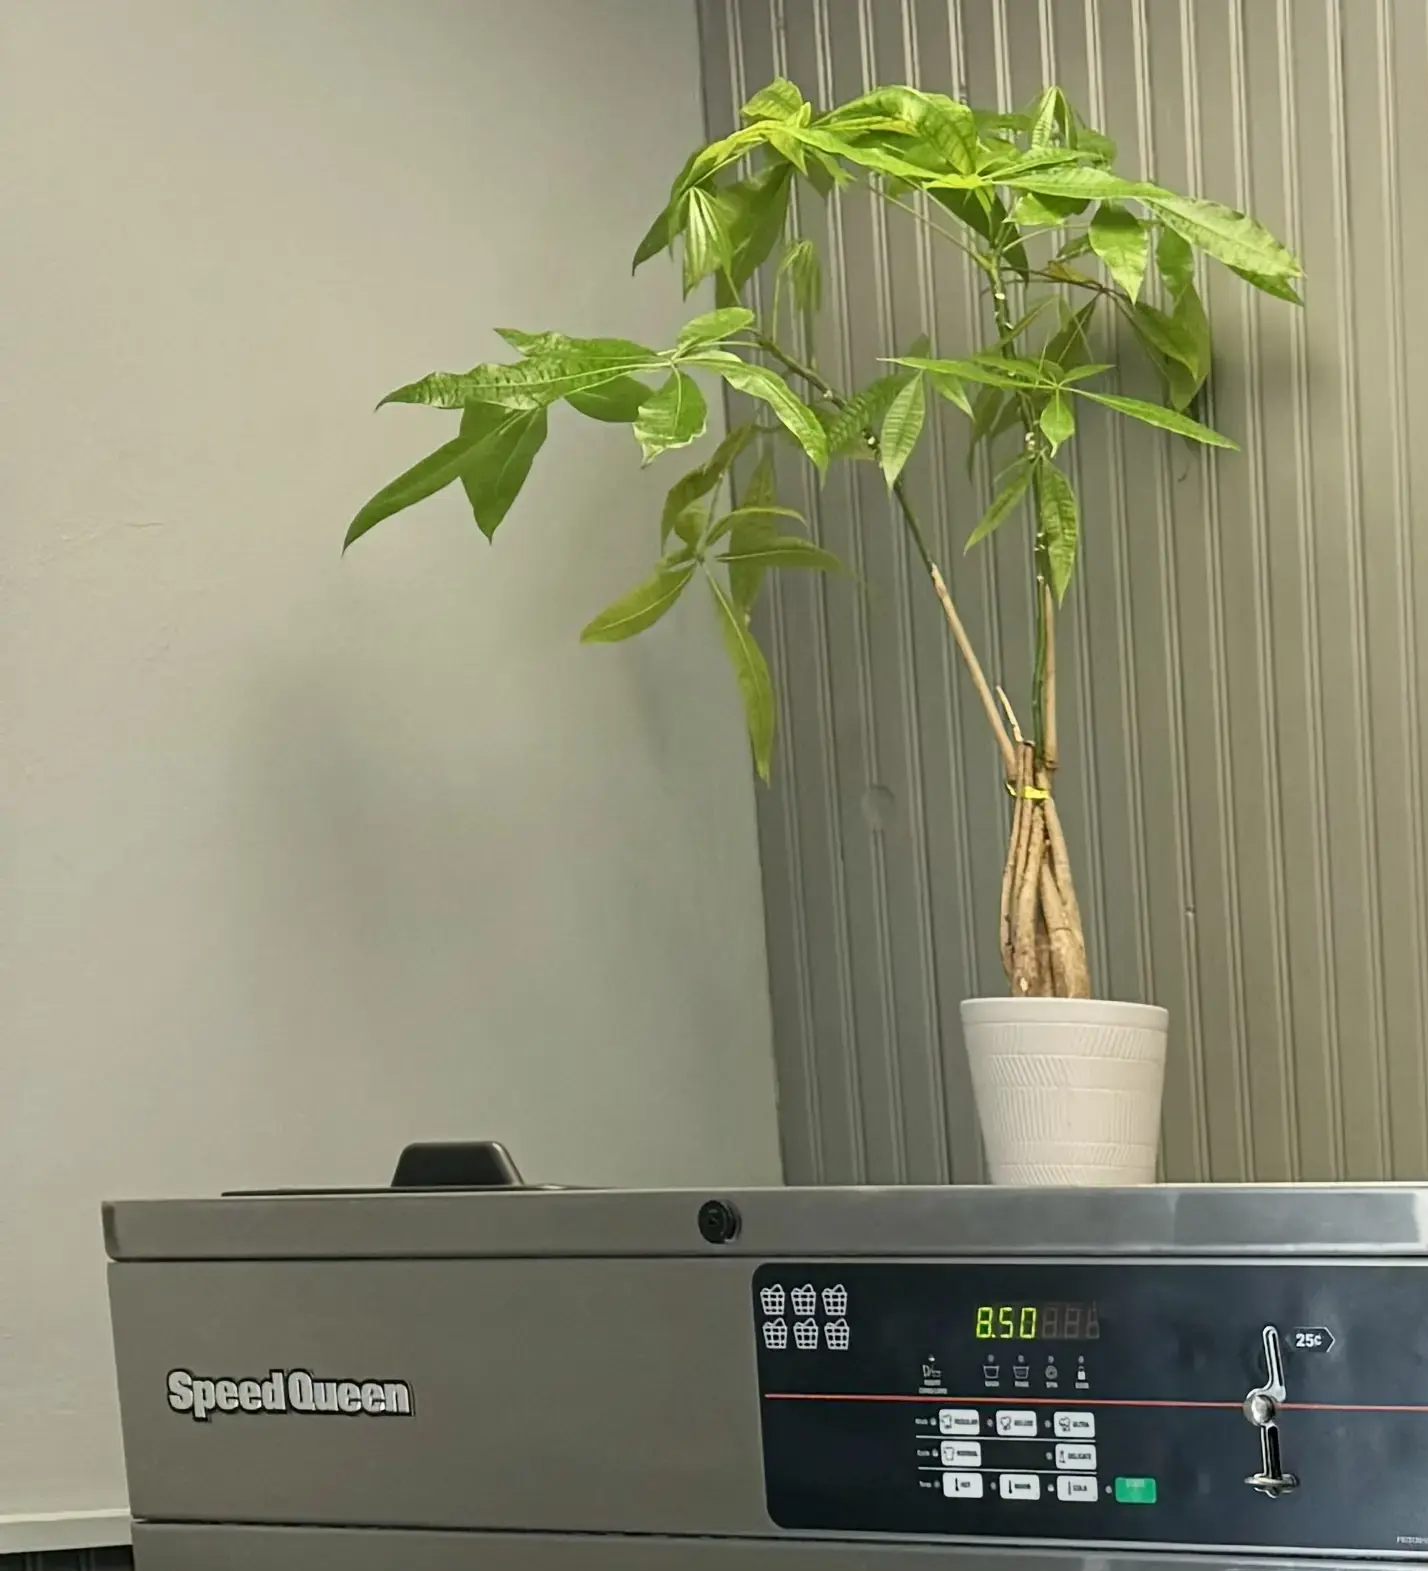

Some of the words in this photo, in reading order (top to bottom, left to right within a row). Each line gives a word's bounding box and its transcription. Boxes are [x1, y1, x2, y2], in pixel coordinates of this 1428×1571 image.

[976, 1307, 1037, 1338] 8.50
[1295, 1333, 1322, 1348] 25¢
[166, 1368, 287, 1422] Speed
[287, 1368, 413, 1417] Queen
